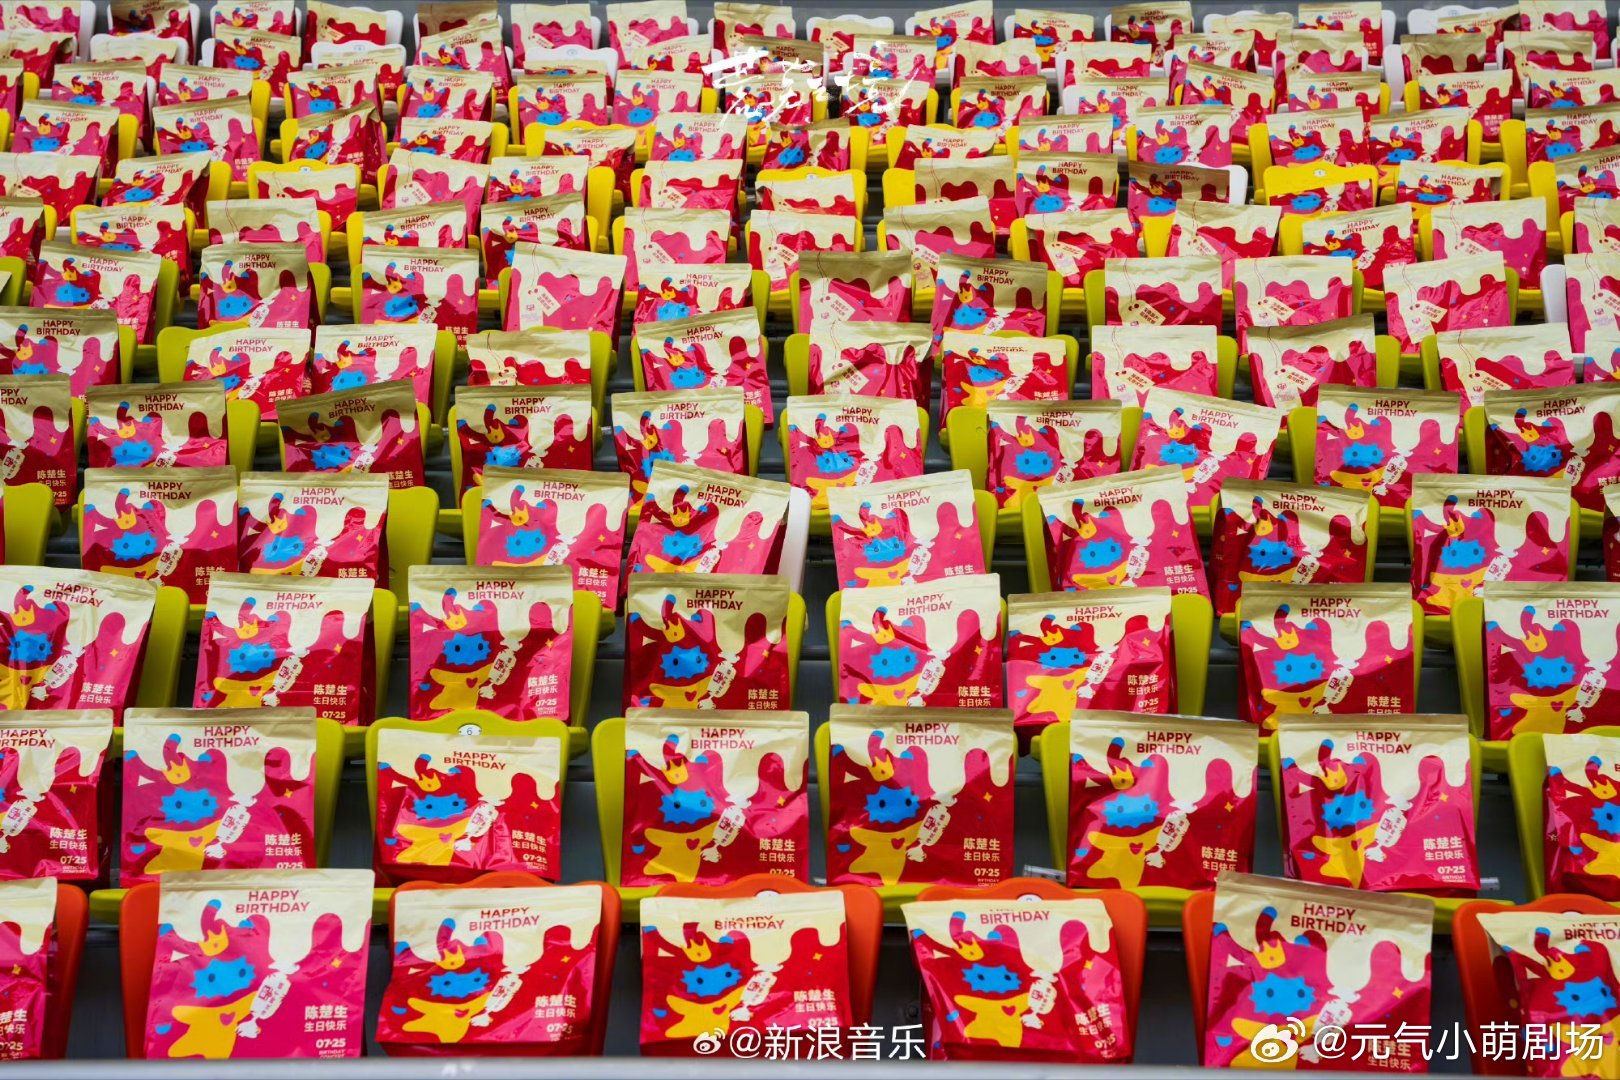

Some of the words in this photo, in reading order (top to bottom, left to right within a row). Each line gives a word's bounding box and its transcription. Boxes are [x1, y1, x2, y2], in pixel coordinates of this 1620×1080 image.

[90, 257, 118, 265] HAPPY
[244, 254, 270, 262] HAPPY
[411, 258, 437, 266] HAPPY
[82, 263, 123, 272] BIRTHDAY
[404, 264, 444, 273] BIRTHDAY
[977, 275, 1014, 284] BIRTHDAY
[36, 327, 80, 335] BIRTHDAY
[687, 326, 716, 335] HAPPY
[682, 331, 723, 342] BIRTHDAY
[145, 394, 177, 403] HAPPY
[335, 398, 367, 409] HAPPY
[512, 398, 544, 406] HAPPY
[1544, 399, 1577, 408] HAPPY
[138, 403, 184, 411] BIRTHDAY
[667, 403, 698, 411] HAPPY
[1375, 400, 1410, 408] HAPPY
[329, 405, 375, 418] BIRTHDAY
[504, 406, 550, 414] BIRTHDAY
[660, 410, 705, 419] BIRTHDAY
[842, 408, 872, 416] HAPPY
[1201, 408, 1233, 420] HAPPY
[1367, 408, 1417, 416] BIRTHDAY
[1536, 407, 1585, 417] BIRTHDAY
[836, 416, 879, 424] BIRTHDAY
[1036, 417, 1081, 426] BIRTHDAY
[1192, 414, 1238, 428] BIRTHDAY
[148, 482, 183, 490] HAPPY
[543, 482, 578, 491] HAPPY
[707, 484, 741, 498] HAPPY
[140, 490, 191, 500] BIRTHDAY
[301, 488, 337, 496] HAPPY
[534, 490, 585, 501] BIRTHDAY
[887, 490, 922, 502] HAPPY
[1099, 487, 1133, 498] HAPPY
[1477, 490, 1514, 499] HAPPY
[293, 496, 344, 505] BIRTHDAY
[697, 492, 747, 508] BIRTHDAY
[881, 497, 931, 509] BIRTHDAY
[1094, 494, 1143, 507] BIRTHDAY
[1281, 493, 1317, 503] HAPPY
[1273, 501, 1325, 511] BIRTHDAY
[1468, 500, 1522, 509] BIRTHDAY
[55, 582, 97, 595] HAPPY
[476, 582, 515, 590] HAPPY
[44, 590, 103, 607] BIRTHDAY
[277, 592, 315, 601] HAPPY
[468, 591, 524, 600] BIRTHDAY
[695, 590, 735, 599] HAPPY
[686, 600, 743, 610] BIRTHDAY
[907, 594, 944, 606] HAPPY
[1310, 598, 1351, 607] HAPPY
[1556, 600, 1599, 608] HAPPY
[266, 601, 322, 610] BIRTHDAY
[898, 602, 952, 615] BIRTHDAY
[1075, 606, 1114, 615] HAPPY
[1067, 611, 1122, 622] BIRTHDAY
[1302, 608, 1361, 618] BIRTHDAY
[1547, 610, 1609, 618] BIRTHDAY
[528, 675, 557, 686] 陈楚生
[1127, 676, 1158, 686] 陈楚生
[82, 683, 114, 694] 陈楚生
[314, 684, 347, 695] 陈楚生
[528, 687, 557, 696] 生日快乐
[958, 686, 990, 698] 陈楚生
[1128, 687, 1158, 695] 生日快乐
[79, 694, 111, 704] 生日快乐
[748, 689, 778, 700] 陈楚生
[313, 697, 346, 705] 生日快乐
[958, 699, 990, 707] 生日快乐
[1367, 696, 1401, 707] 陈楚生
[204, 726, 251, 736] HAPPY
[905, 723, 949, 733] HAPPY
[1, 729, 47, 738] HAPPY
[701, 728, 744, 739] HAPPY
[1147, 731, 1191, 743] HAPPY
[1356, 731, 1400, 741] HAPPY
[194, 737, 259, 748] BIRTHDAY
[691, 739, 754, 750] BIRTHDAY
[896, 734, 959, 745] BIRTHDAY
[1137, 742, 1201, 755] BIRTHDAY
[1347, 742, 1411, 753] BIRTHDAY
[453, 751, 496, 760] HAPPY
[444, 756, 506, 770] BIRTHDAY
[50, 828, 87, 840] 陈楚生
[512, 830, 547, 847] 陈楚生
[265, 833, 302, 846] 陈楚生
[759, 838, 796, 851] 陈楚生
[964, 838, 1000, 851] 陈楚生
[1424, 837, 1463, 850] 陈楚生
[50, 840, 87, 851] 生日快乐
[512, 841, 546, 852] 生日快乐
[265, 847, 302, 856] 生日快乐
[964, 852, 1000, 861] 生日快乐
[1202, 847, 1237, 862] 陈楚生
[1425, 851, 1463, 860] 生日快乐
[759, 852, 795, 862] 生日快乐
[248, 890, 299, 901] HAPPY
[236, 901, 310, 913] BIRTHDAY
[481, 906, 530, 918] HAPPY
[1304, 903, 1355, 920] HAPPY
[981, 911, 1050, 924] BIRTHDAY
[469, 915, 540, 931] BIRTHDAY
[715, 919, 784, 929] BIRTHDAY
[1291, 915, 1366, 935] BIRTHDAY
[1564, 929, 1620, 940] BIRTHD
[794, 989, 835, 1002] 陈楚生
[535, 995, 576, 1007] 陈楚生
[795, 1002, 836, 1012] 生日快乐
[304, 1005, 348, 1020] 陈楚生
[535, 1009, 576, 1018] 生日快乐
[304, 1020, 347, 1032] 生日快乐
[1367, 1056, 1411, 1069] 生日快乐
